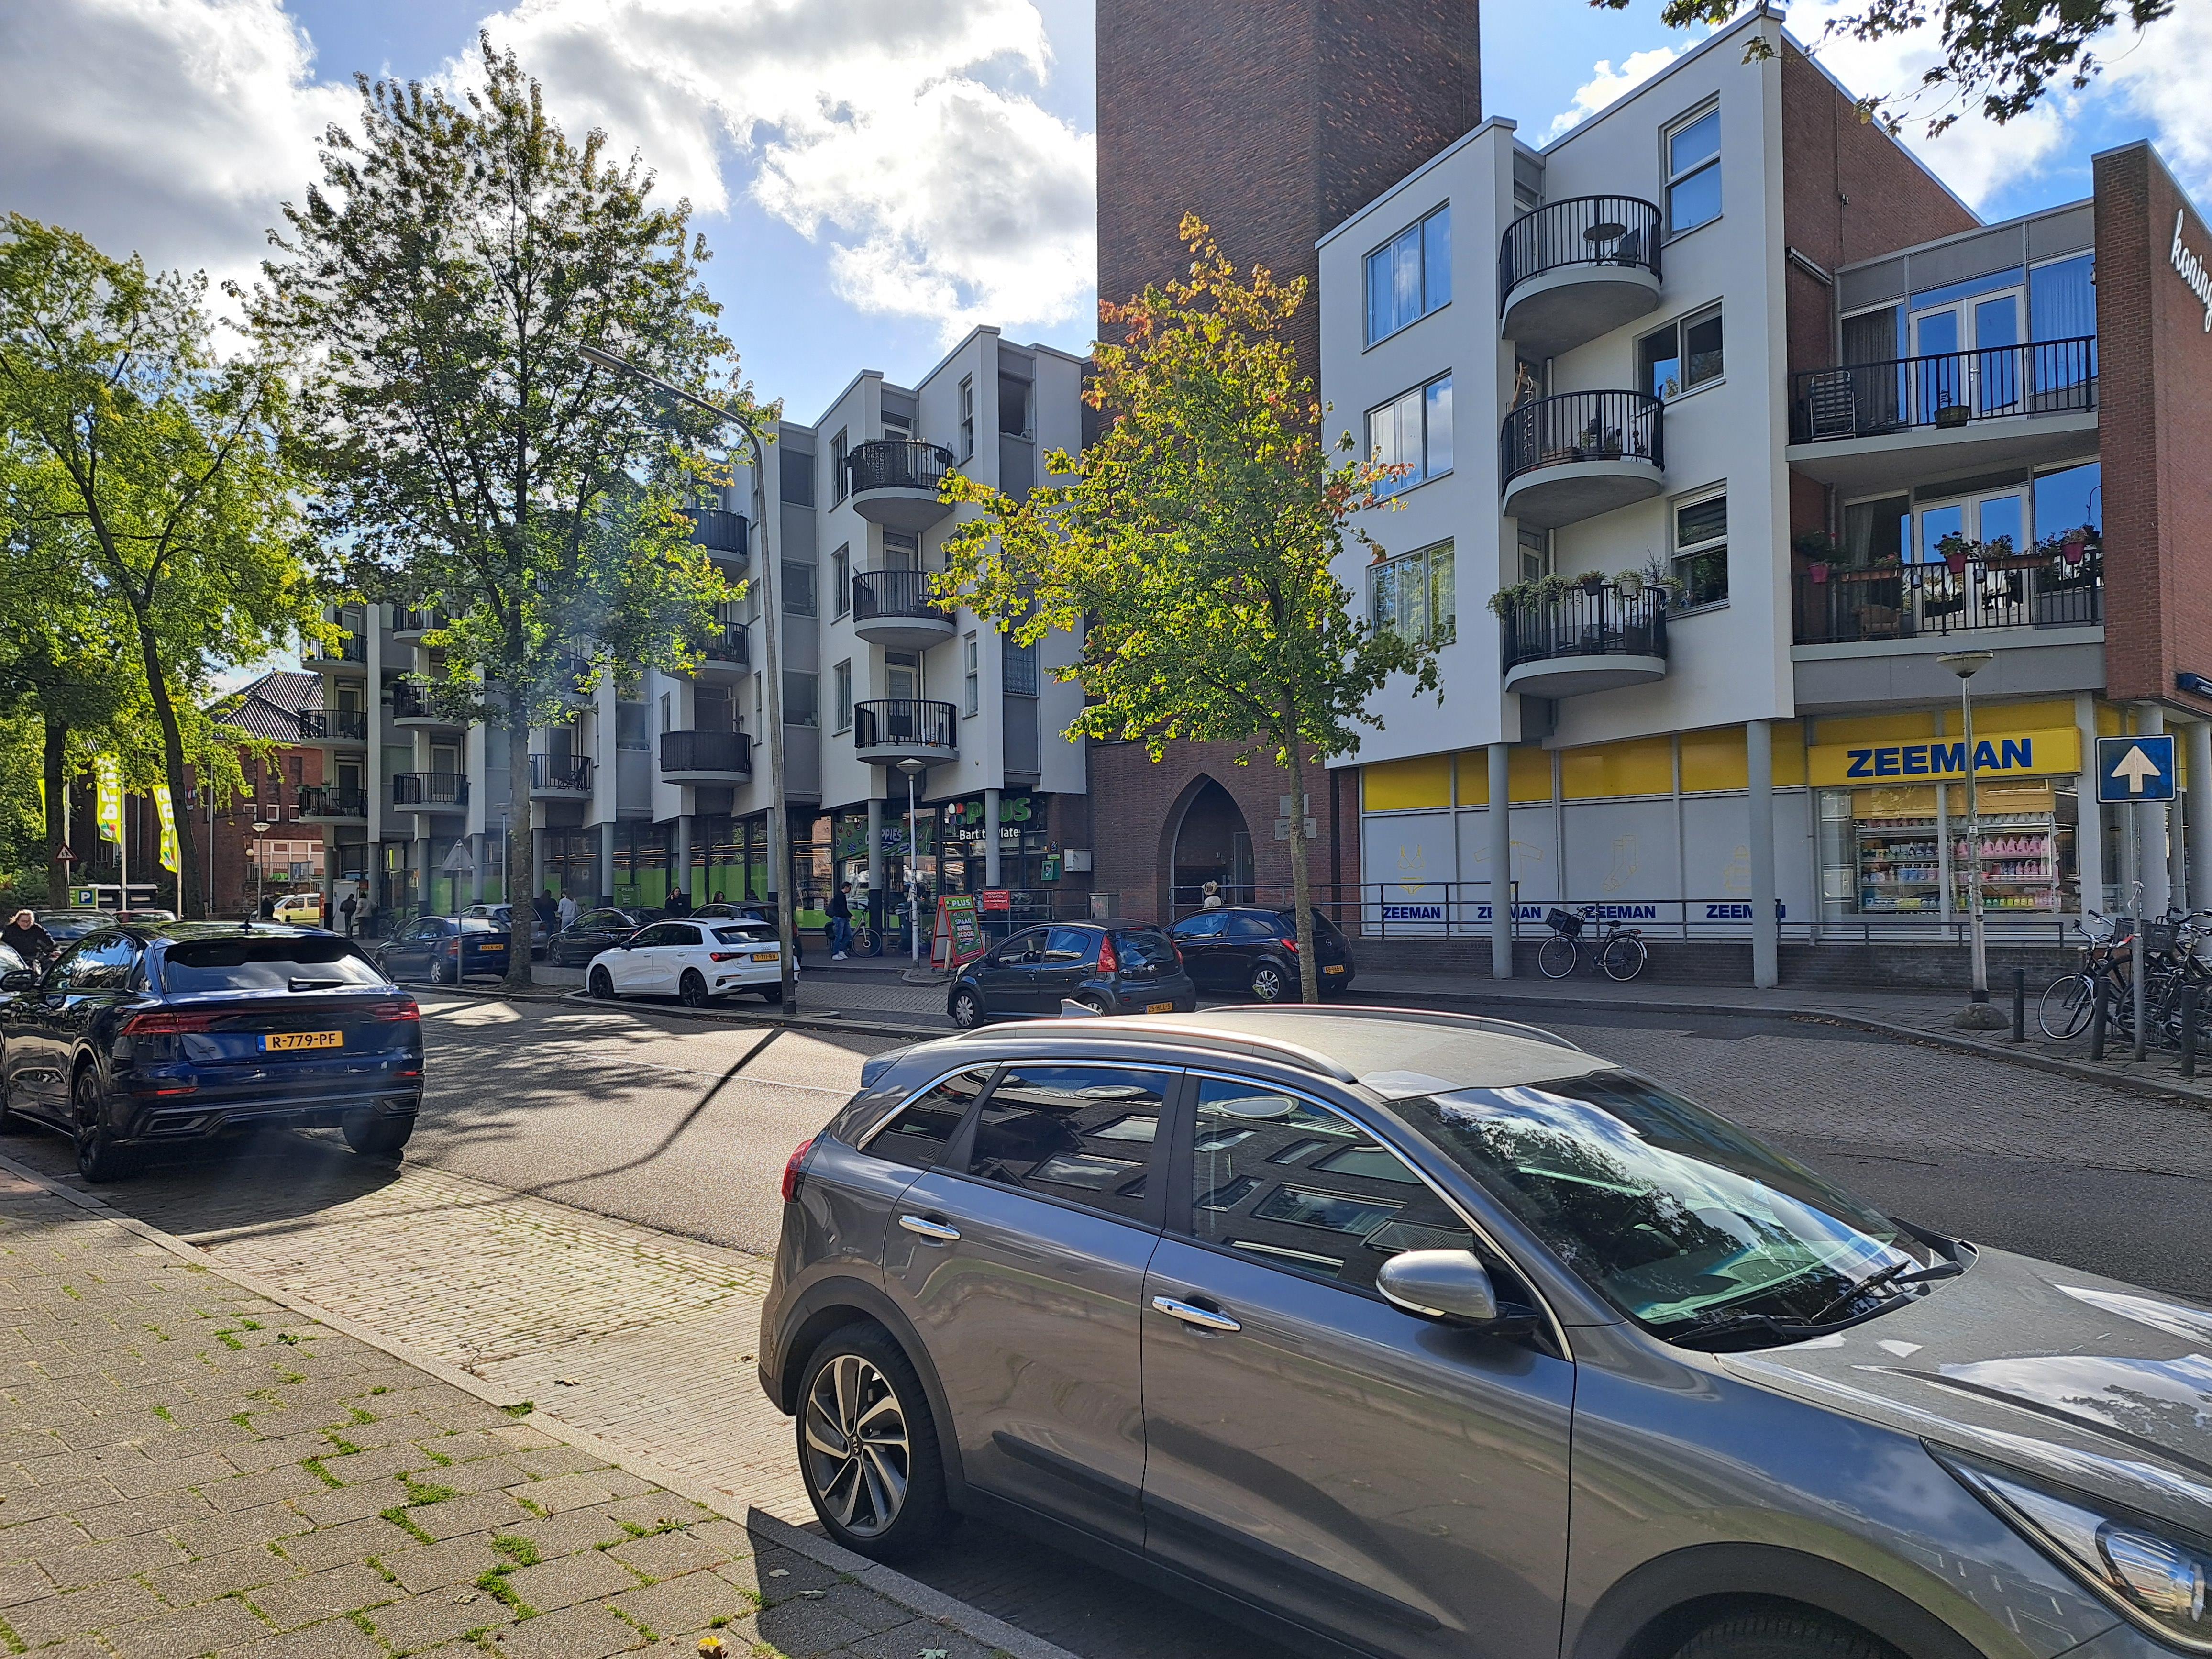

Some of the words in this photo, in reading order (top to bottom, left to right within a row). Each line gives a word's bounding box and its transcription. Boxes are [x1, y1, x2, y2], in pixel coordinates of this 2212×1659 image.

[1847, 738, 2032, 777] ZEEMAN
[967, 798, 1031, 824] PUS
[960, 829, 979, 840] Bart
[998, 827, 1019, 838] late
[80, 892, 91, 902] P
[1383, 907, 1440, 918] ZEEMAN
[1477, 906, 1541, 918] ZMAN
[1585, 906, 1656, 918] ZEEMAN
[1706, 904, 1786, 918] ZEEMN
[1148, 1003, 1171, 1012] 25-HLL-5
[273, 1033, 335, 1048] R-779-PF
